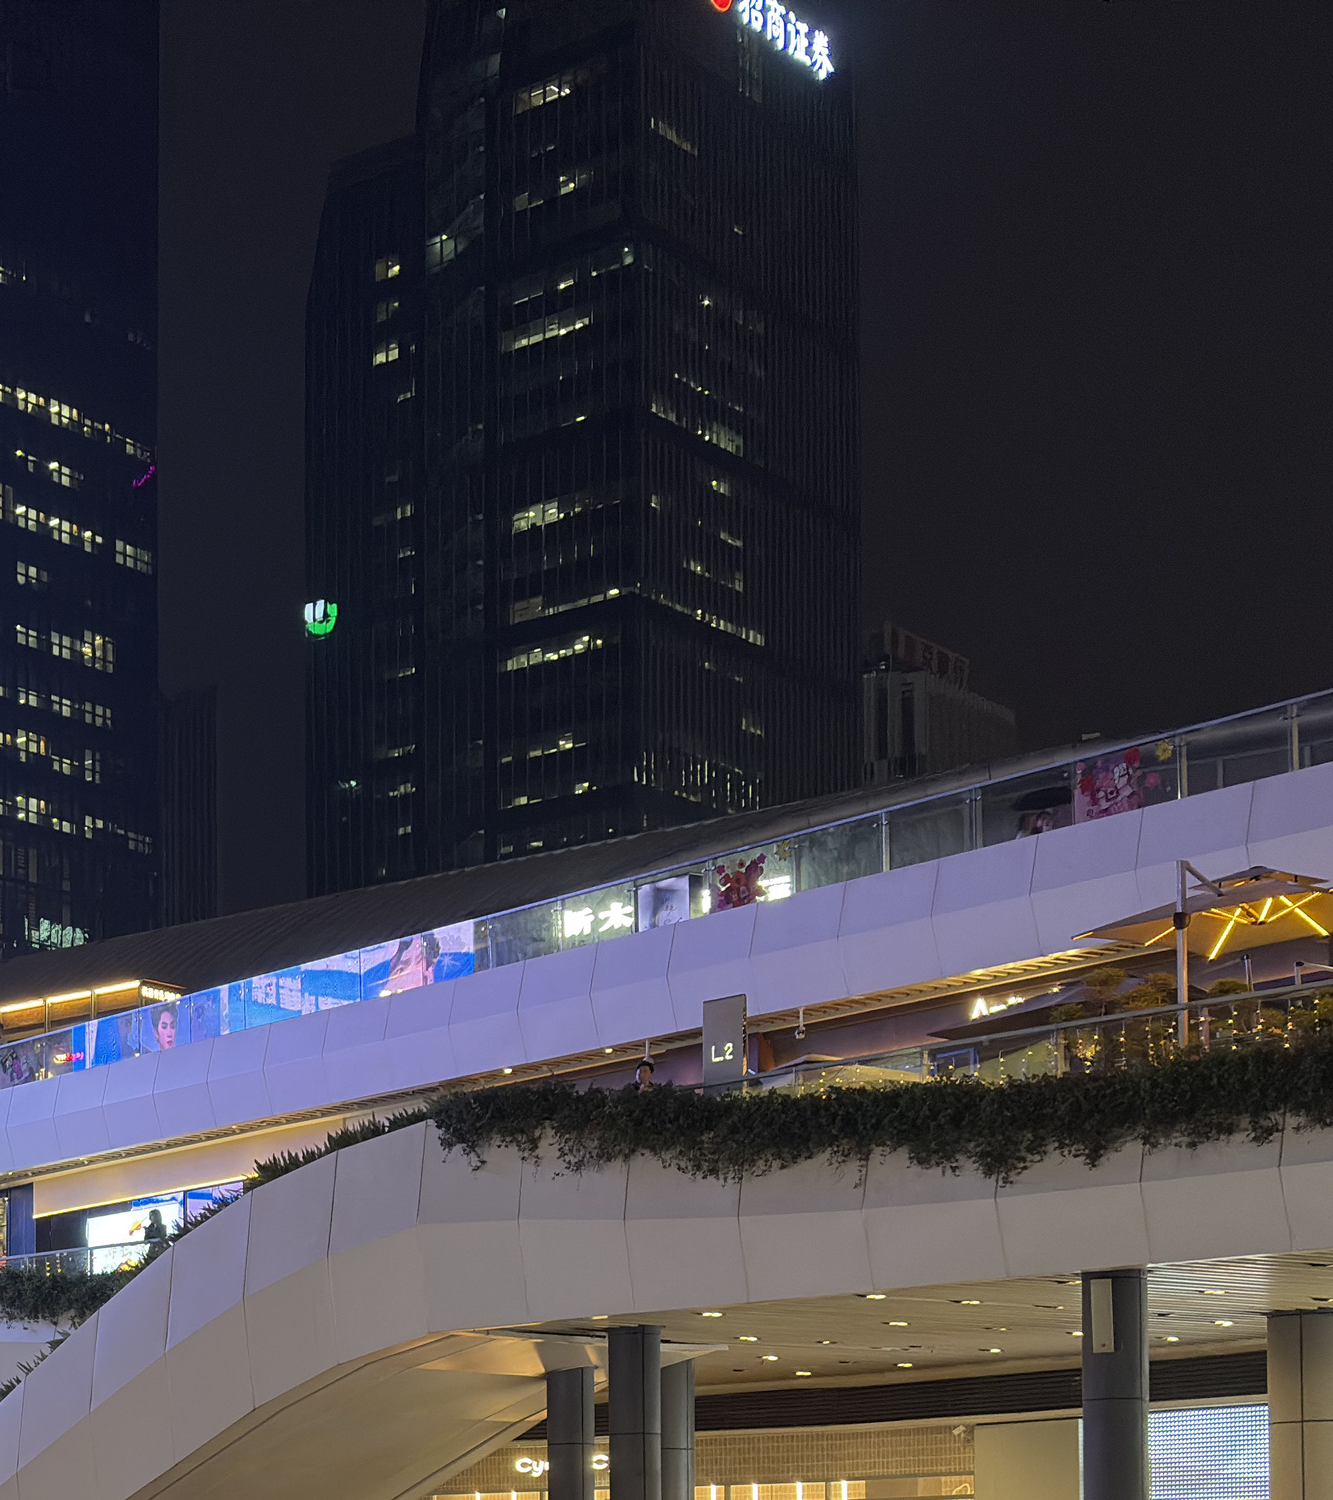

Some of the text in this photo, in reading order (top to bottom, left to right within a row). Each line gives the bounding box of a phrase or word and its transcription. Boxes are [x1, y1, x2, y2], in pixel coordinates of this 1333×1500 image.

[738, 0, 834, 80] 招商证券
[711, 1042, 734, 1063] L2
